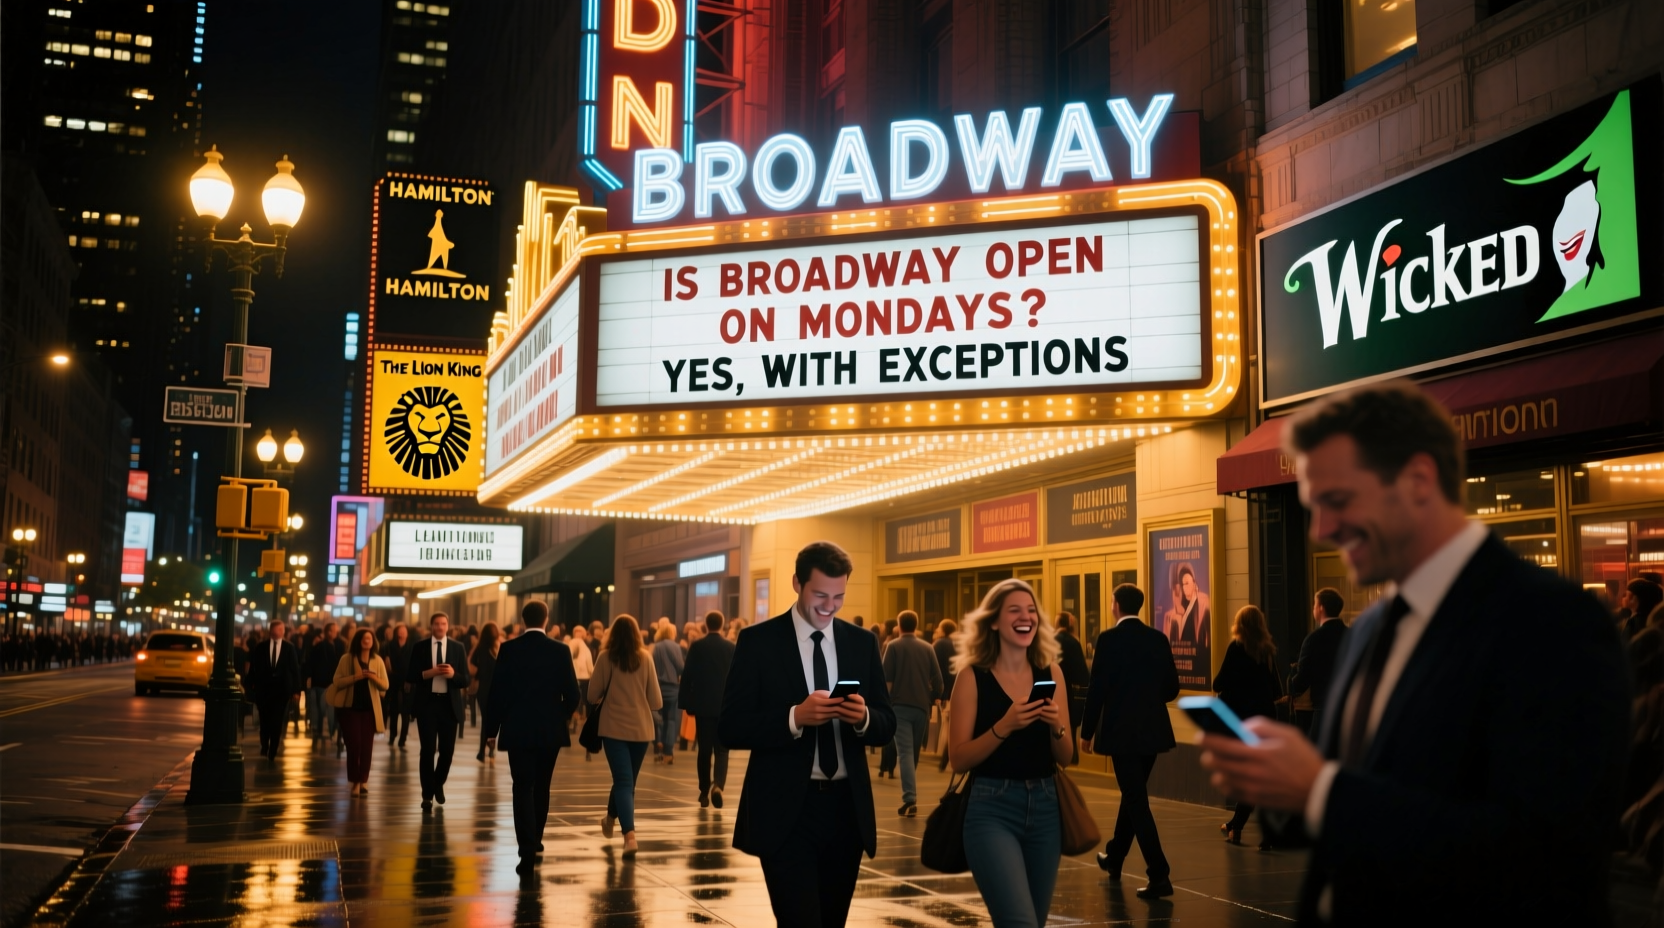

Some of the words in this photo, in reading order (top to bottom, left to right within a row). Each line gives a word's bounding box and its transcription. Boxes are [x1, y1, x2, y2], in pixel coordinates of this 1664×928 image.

[632, 93, 1175, 224] BROADWAY
[389, 180, 492, 206] HAMILTON
[385, 277, 490, 301] HAMILTON
[664, 265, 699, 302] IS
[719, 246, 961, 298] BROADWAY
[985, 235, 1104, 279] OPEN
[719, 307, 776, 344] ON
[799, 288, 1047, 340] MONDAYS?
[380, 359, 409, 375] THE
[662, 356, 744, 396] YES,
[761, 350, 858, 388] WITH
[879, 335, 1129, 383] EXCEPTIONS
